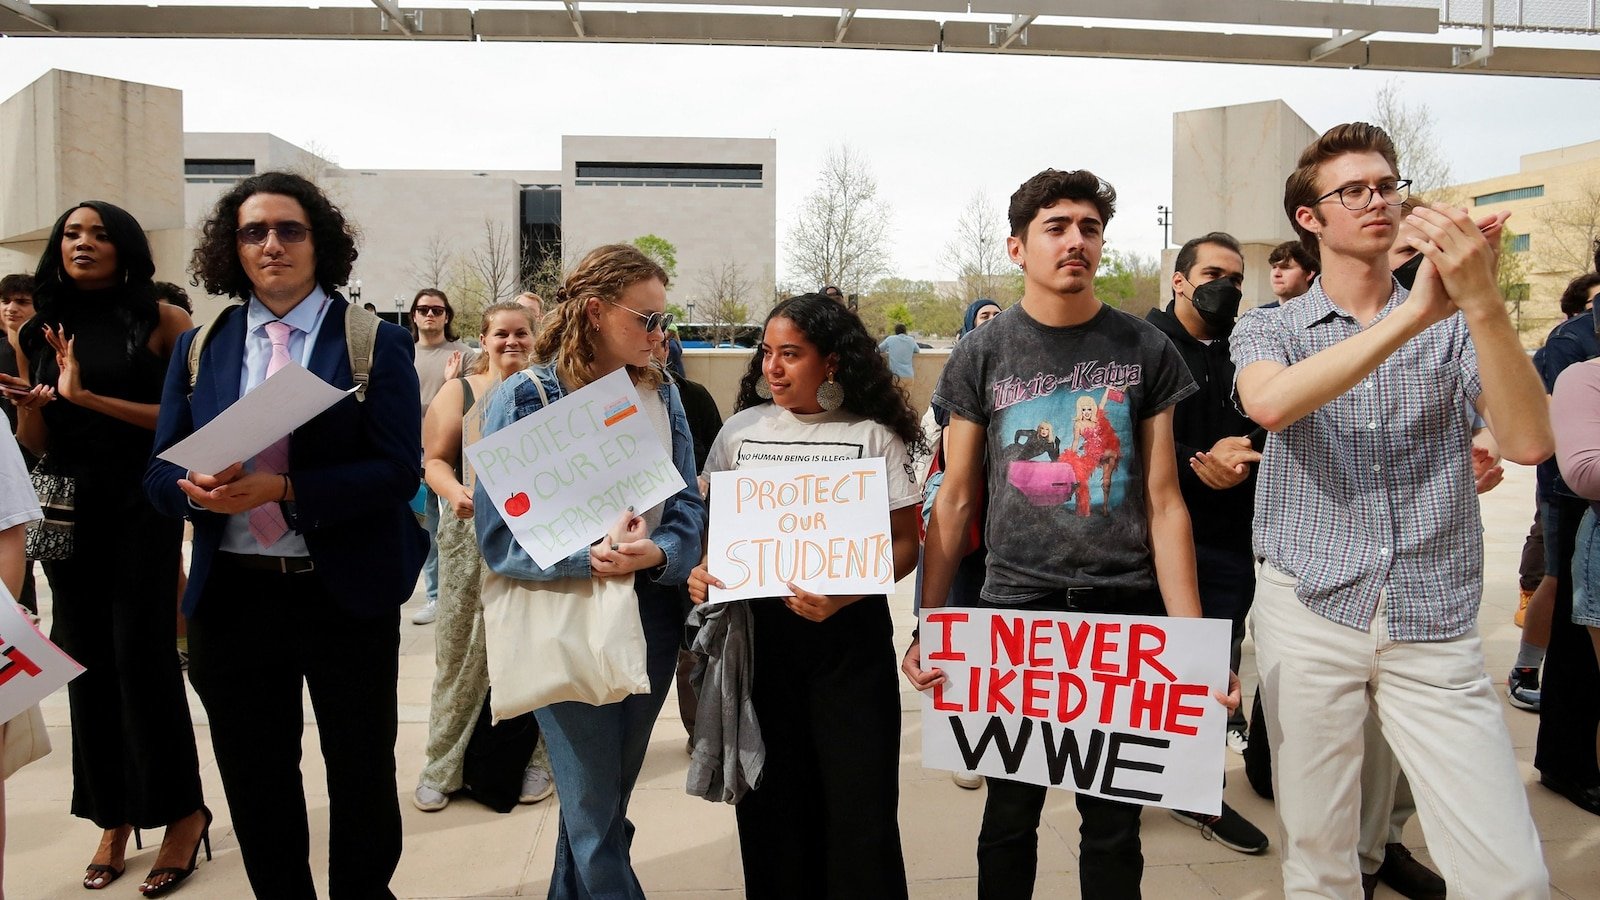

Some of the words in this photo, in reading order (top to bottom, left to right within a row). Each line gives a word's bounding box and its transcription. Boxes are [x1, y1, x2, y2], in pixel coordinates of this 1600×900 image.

[1071, 360, 1142, 392] Katya
[477, 399, 601, 486] PROTECT
[741, 453, 751, 461] NO
[752, 453, 783, 462] HUMAN
[533, 453, 599, 500] OUR
[736, 470, 877, 513] PROTECT
[529, 460, 674, 551] DEPARTMENT
[778, 512, 827, 533] OUR
[725, 533, 892, 590] STUDENTS
[926, 613, 969, 661] I
[990, 614, 1178, 682] NEVER
[949, 715, 1171, 802] WWE
